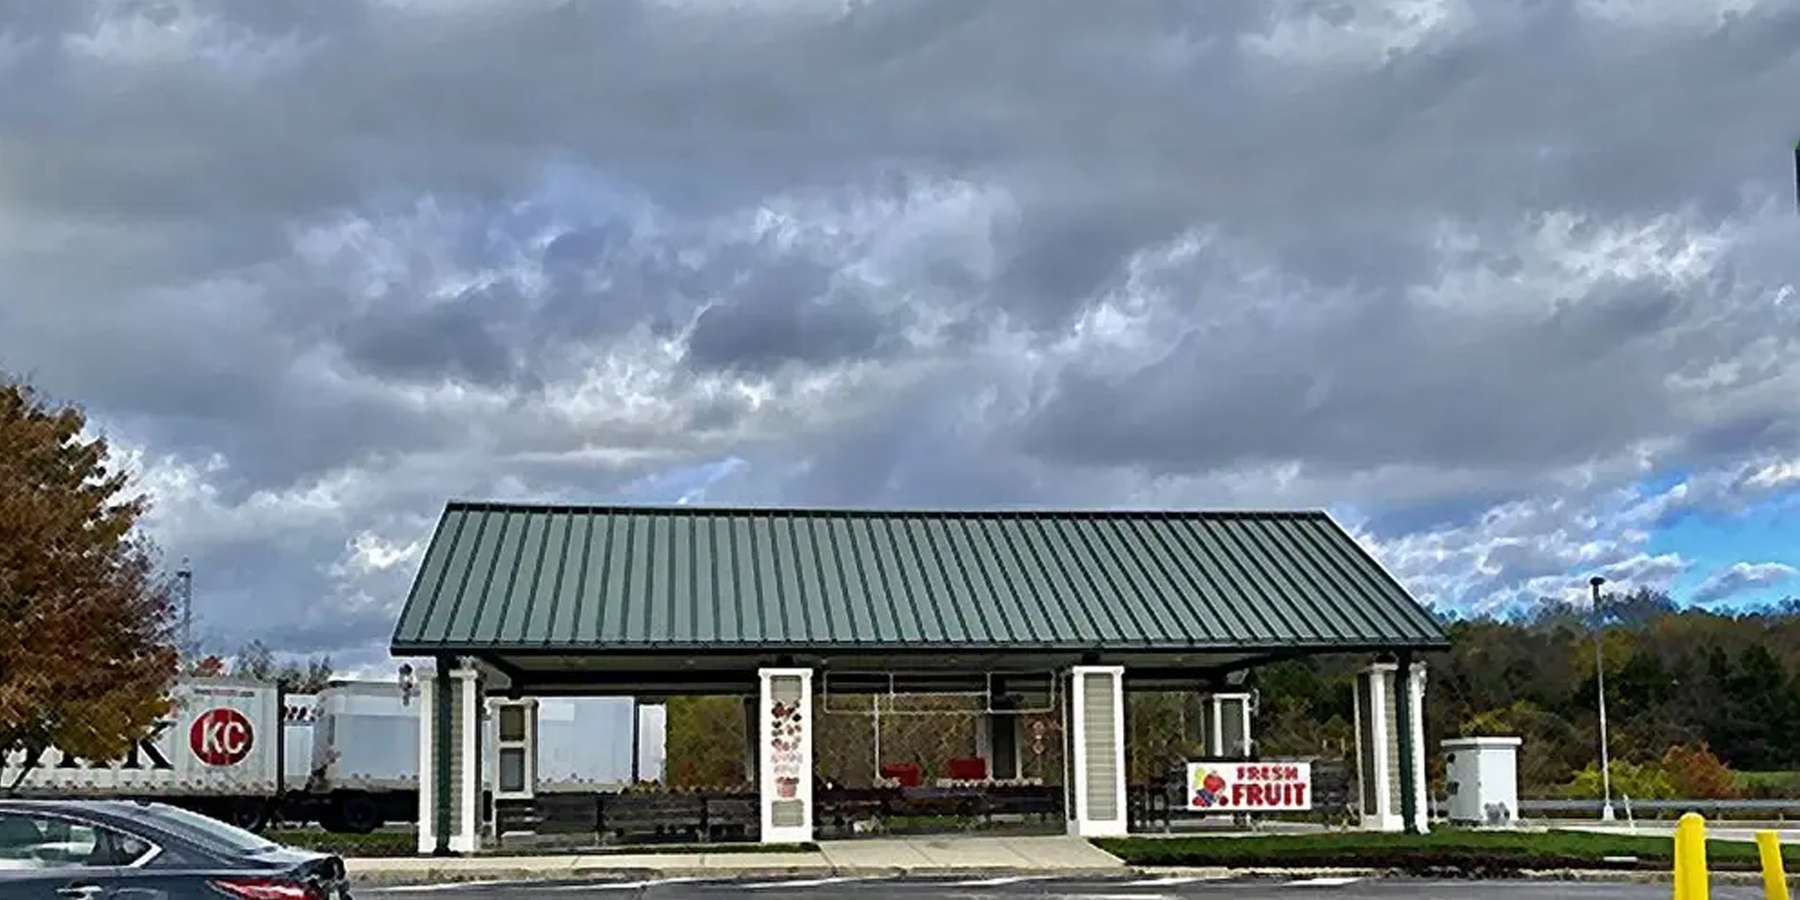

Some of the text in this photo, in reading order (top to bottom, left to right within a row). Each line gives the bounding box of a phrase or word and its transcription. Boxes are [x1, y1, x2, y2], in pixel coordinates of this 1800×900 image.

[201, 716, 246, 754] KC
[1236, 766, 1299, 780] FRESH
[1232, 783, 1306, 806] FRUIT
